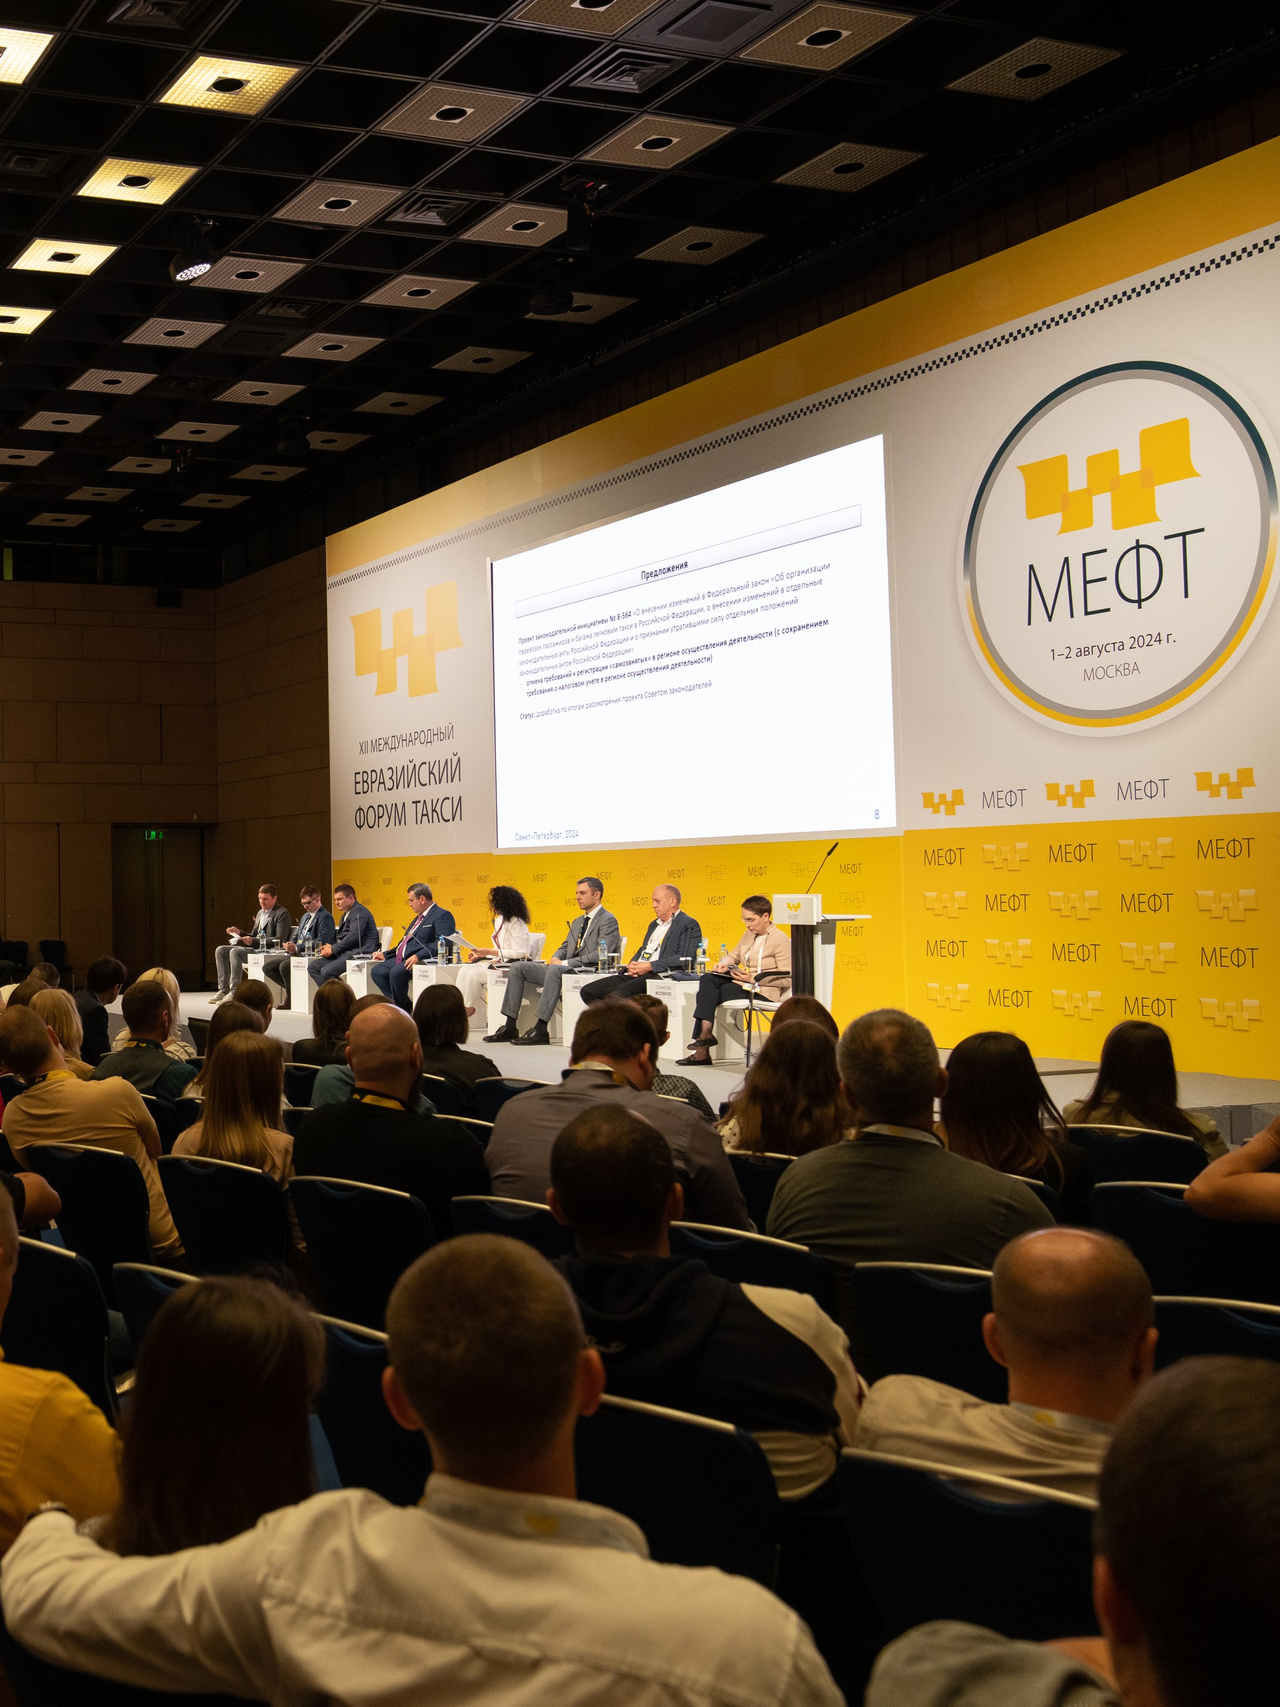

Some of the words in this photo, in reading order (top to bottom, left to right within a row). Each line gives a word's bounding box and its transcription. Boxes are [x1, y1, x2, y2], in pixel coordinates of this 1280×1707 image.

[641, 561, 689, 581] Предложения
[1027, 527, 1205, 626] МЕФТ
[519, 636, 534, 645] Проект
[535, 624, 576, 640] законодательной
[577, 618, 608, 629] инициативы
[641, 604, 667, 614] внесении
[668, 594, 700, 607] изменений
[706, 581, 749, 597] Федеральный
[751, 579, 769, 588] закон
[786, 564, 831, 579] организации
[526, 678, 543, 686] отмена
[544, 671, 572, 683] требований
[577, 665, 608, 677] регистрации
[656, 650, 680, 661] регионе
[681, 640, 727, 655] осуществления
[728, 631, 773, 647] деятельности
[782, 619, 829, 634] сохранением
[1075, 637, 1125, 659] августа
[1128, 631, 1163, 651] 2024
[1166, 632, 1176, 645] г.
[526, 687, 553, 697] требования
[558, 681, 585, 690] налоговом
[586, 678, 599, 686] учете
[604, 673, 626, 683] регионе
[627, 664, 669, 678] осуществления
[670, 654, 713, 670] деятельности)
[1082, 661, 1141, 682] МОСКВА
[370, 721, 454, 755] МЕЖДУНАРОДНЫЙ
[354, 752, 462, 796] ЕВРАЗИЙСКИЙ
[982, 788, 1027, 809] МЕФТ
[1117, 778, 1169, 801] МЕФТ
[354, 802, 407, 830] ФОРУМ
[412, 796, 463, 825] ТАКСИ
[874, 809, 880, 820] 8
[565, 829, 579, 839] 2024
[923, 848, 965, 866] МЕФТ
[1048, 843, 1097, 864] МЕФТ
[1197, 837, 1255, 859] МЕФТ
[668, 869, 685, 879] МЕФТ
[748, 866, 768, 876] МЕФТ
[839, 863, 862, 874] МЕФТ
[632, 897, 649, 906] МЕФТ
[707, 896, 727, 906] МЕФТ
[985, 893, 1030, 913] МЕФТ
[1120, 892, 1174, 913] МЕФТ
[841, 926, 864, 937] МЕФТ
[926, 939, 968, 958] МЕФТ
[1052, 942, 1101, 963] МЕФТ
[1201, 946, 1259, 969] МЕФТ
[988, 988, 1033, 1009] МЕФТ
[1124, 996, 1177, 1018] МЕФТ
